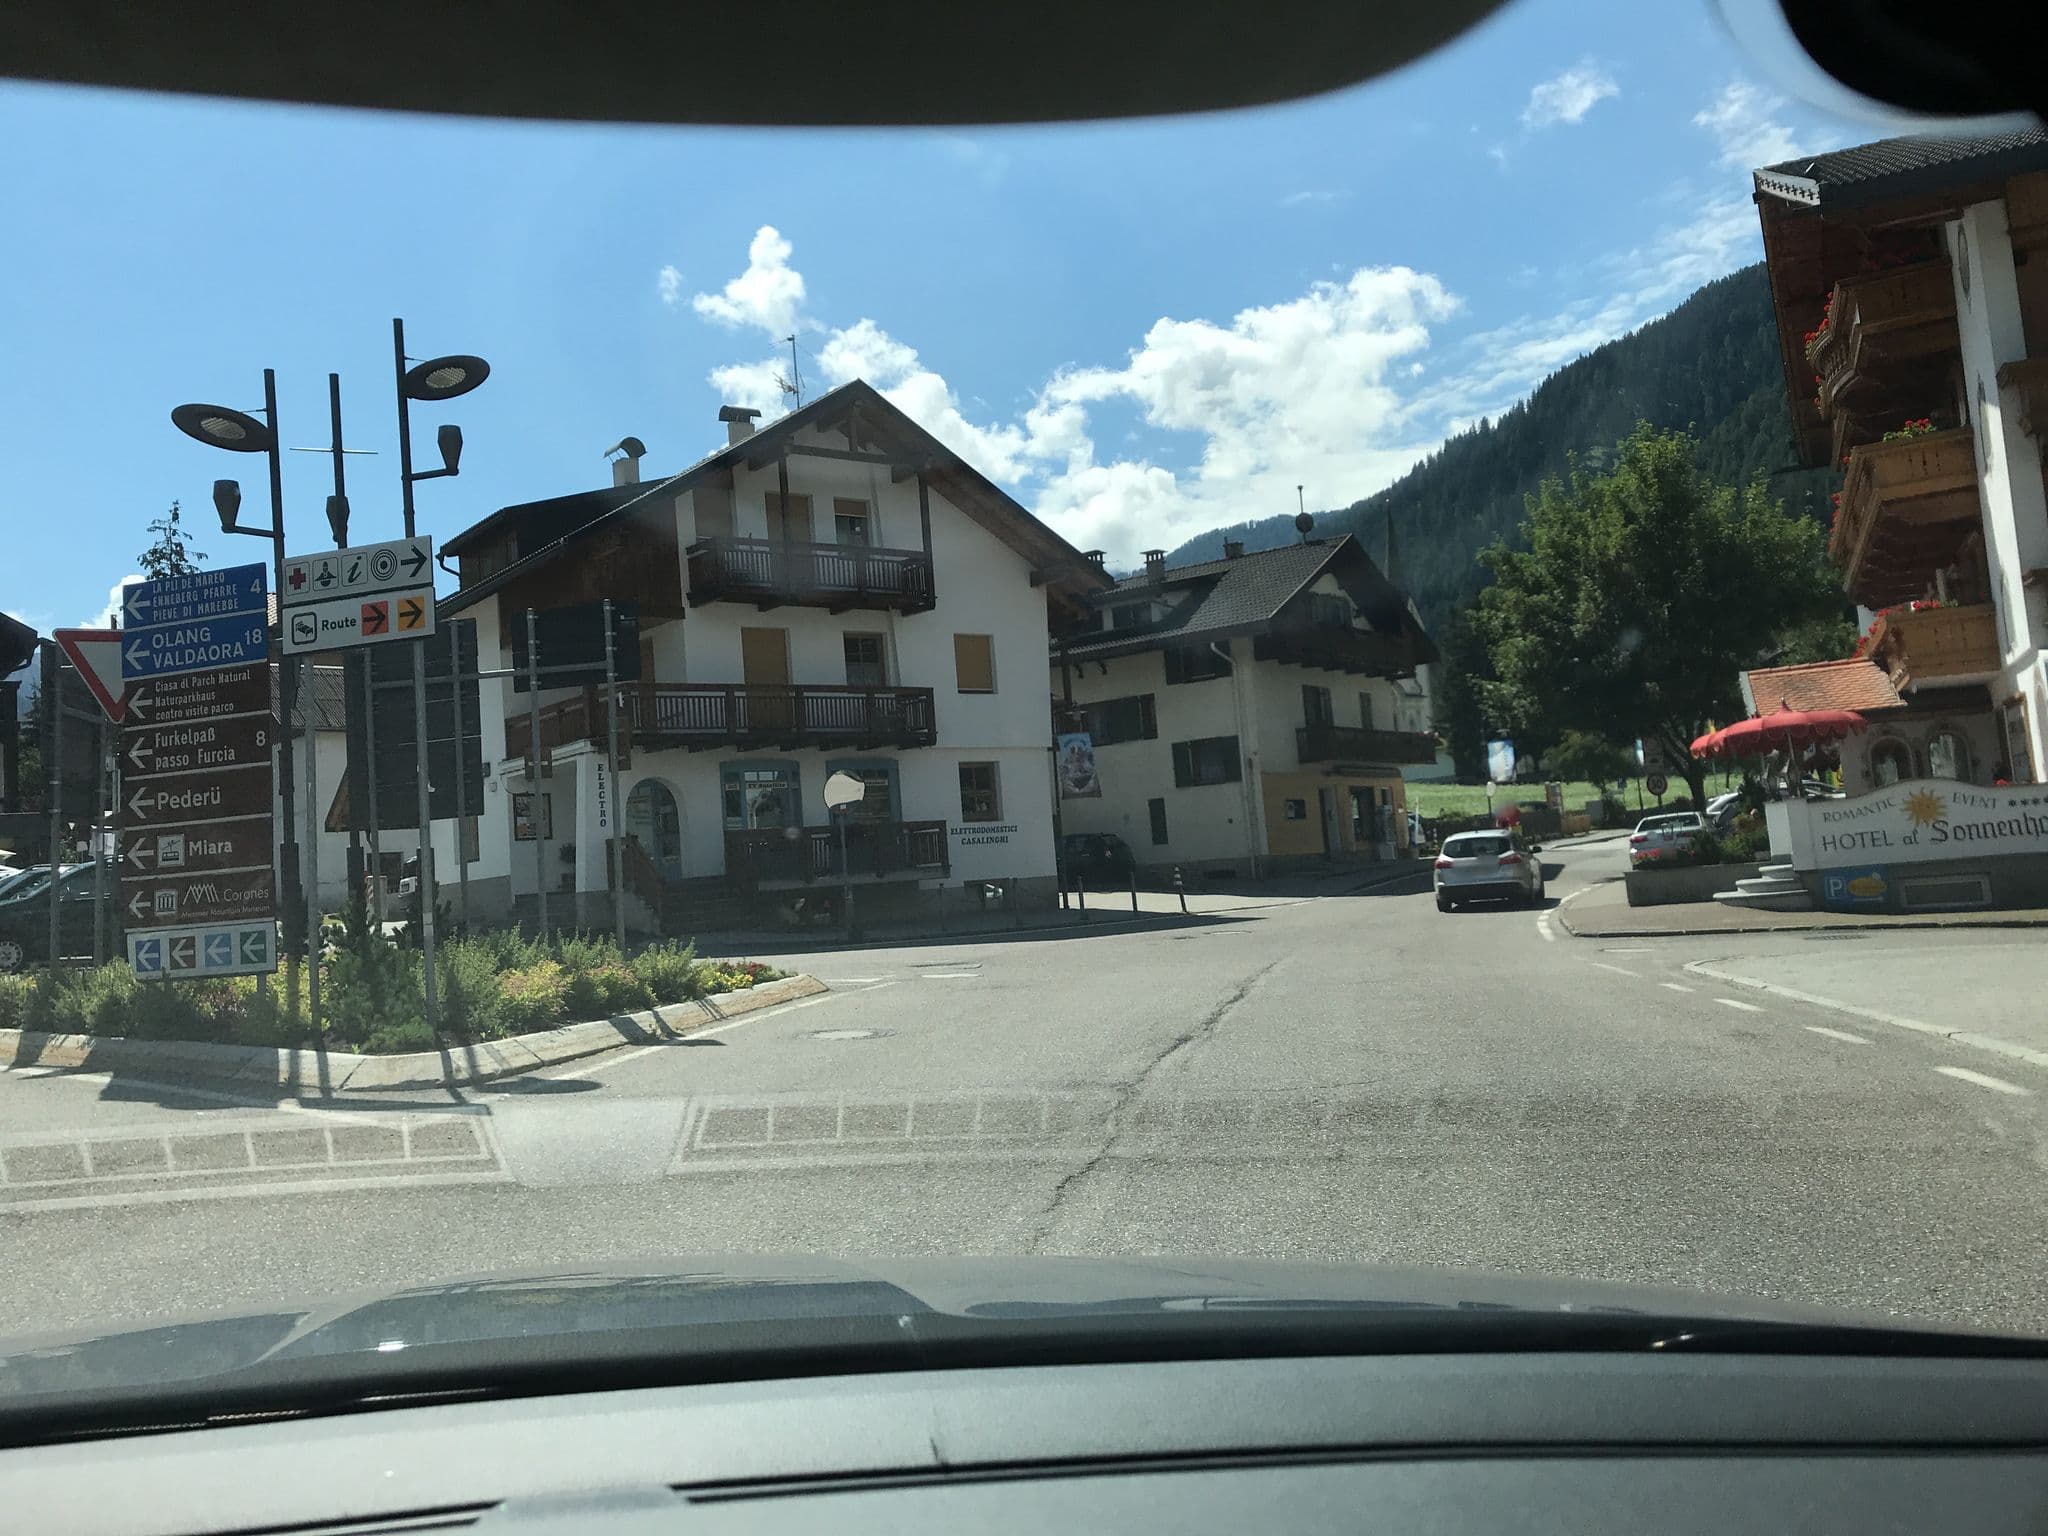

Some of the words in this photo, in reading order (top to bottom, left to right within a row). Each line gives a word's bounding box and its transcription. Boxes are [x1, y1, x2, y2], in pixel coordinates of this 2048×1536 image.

[152, 581, 162, 594] LA
[165, 579, 178, 592] PLI
[181, 578, 193, 589] DE
[195, 572, 225, 587] MAREO
[250, 578, 262, 594] 4
[152, 590, 198, 608] ENNEBERG
[203, 583, 238, 600] PFARRE
[153, 607, 177, 622] PIEVE
[183, 606, 192, 618] DI
[197, 597, 239, 615] MAREBBE
[321, 616, 357, 632] Route
[152, 626, 211, 649] OLANG
[244, 628, 263, 646] 18
[152, 641, 245, 669] VALDAORA
[155, 680, 178, 692] Ciasa
[192, 673, 216, 687] Parch
[218, 669, 251, 682] Natural
[155, 690, 216, 707] Naturparkhaus
[155, 707, 183, 721] centro
[185, 704, 209, 717] visite
[211, 702, 234, 715] parco
[155, 727, 216, 748] Furkelpaß
[255, 730, 266, 747] 8
[155, 753, 190, 771] passo
[197, 745, 236, 764] Furcia
[156, 787, 222, 811] Pederü
[597, 763, 608, 828] ELECTRO
[1822, 798, 1897, 825] ROMANTIC
[1953, 792, 1998, 809] EVENT
[950, 825, 1018, 836] ELETTRODOMESTICI
[961, 836, 1009, 846] CASALINGHI
[1822, 830, 1894, 852] HOTEL
[188, 840, 233, 857] Miara
[223, 887, 270, 903] Corones
[1828, 879, 1844, 898] P
